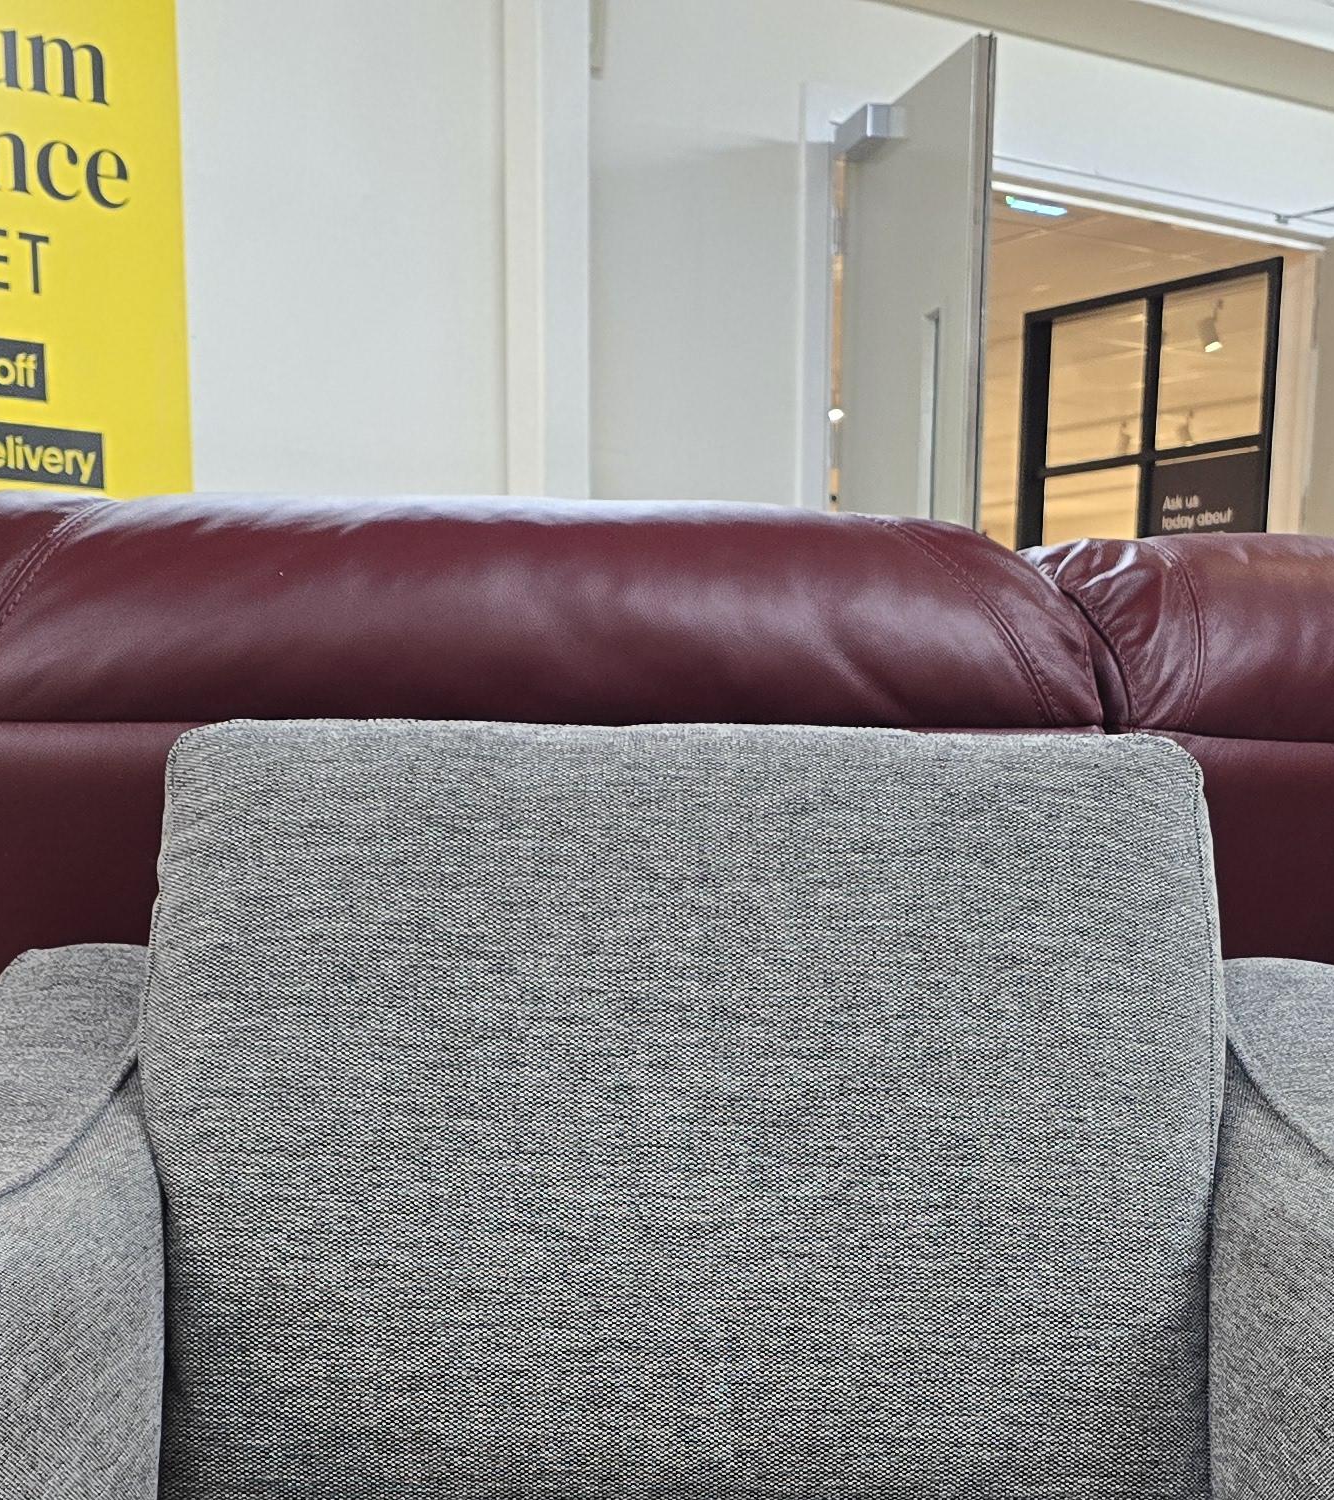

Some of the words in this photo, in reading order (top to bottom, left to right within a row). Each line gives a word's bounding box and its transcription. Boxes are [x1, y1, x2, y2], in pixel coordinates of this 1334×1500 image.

[1162, 494, 1183, 511] Ask
[1185, 495, 1200, 509] us
[1162, 513, 1194, 531] today
[1196, 507, 1233, 527] about
